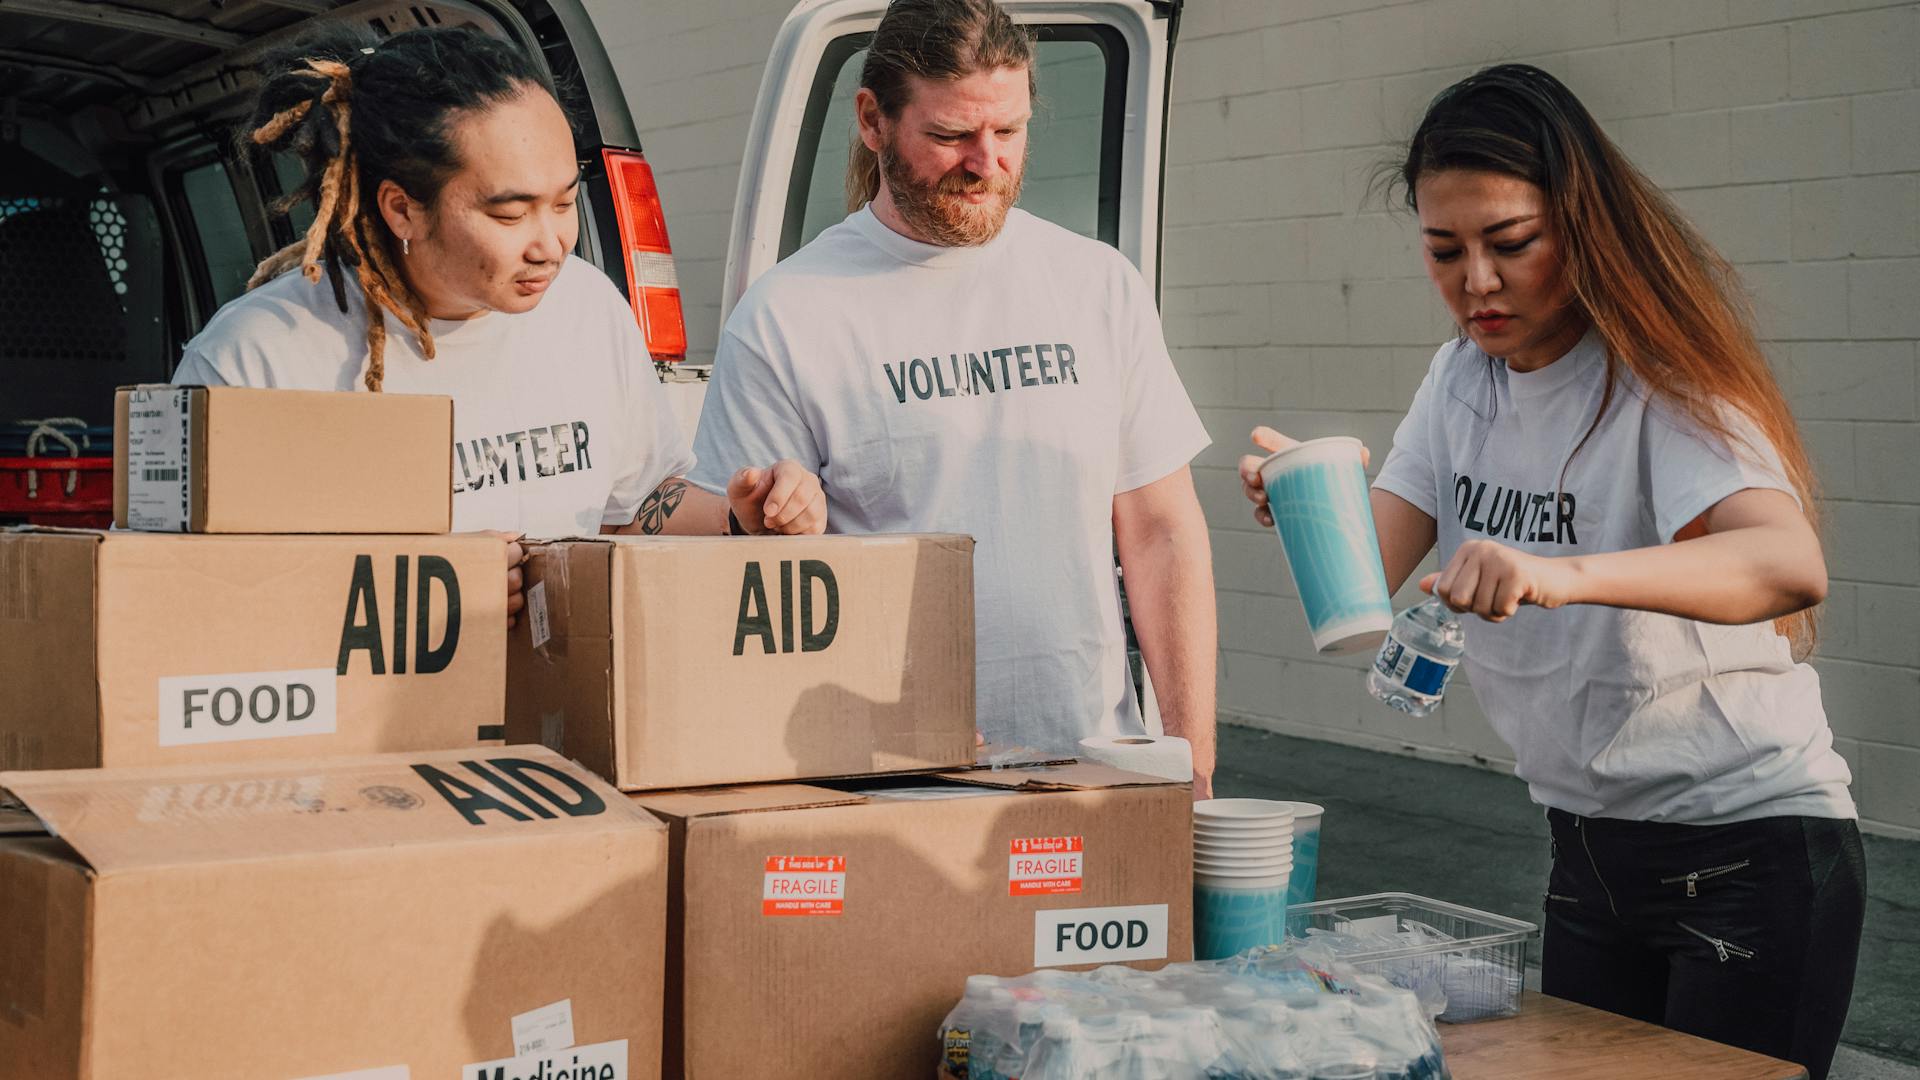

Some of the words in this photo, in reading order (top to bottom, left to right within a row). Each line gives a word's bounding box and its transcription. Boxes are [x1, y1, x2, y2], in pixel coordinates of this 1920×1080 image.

[883, 343, 1079, 403] VOLUNTEER
[453, 420, 592, 493] UNTEER
[336, 554, 461, 676] AID
[732, 559, 840, 656] AID
[183, 683, 316, 729] FOOD
[409, 757, 607, 826] AID
[772, 879, 839, 894] FRAGILE
[1016, 858, 1077, 875] FRAGILE
[1055, 919, 1149, 953] FOOD
